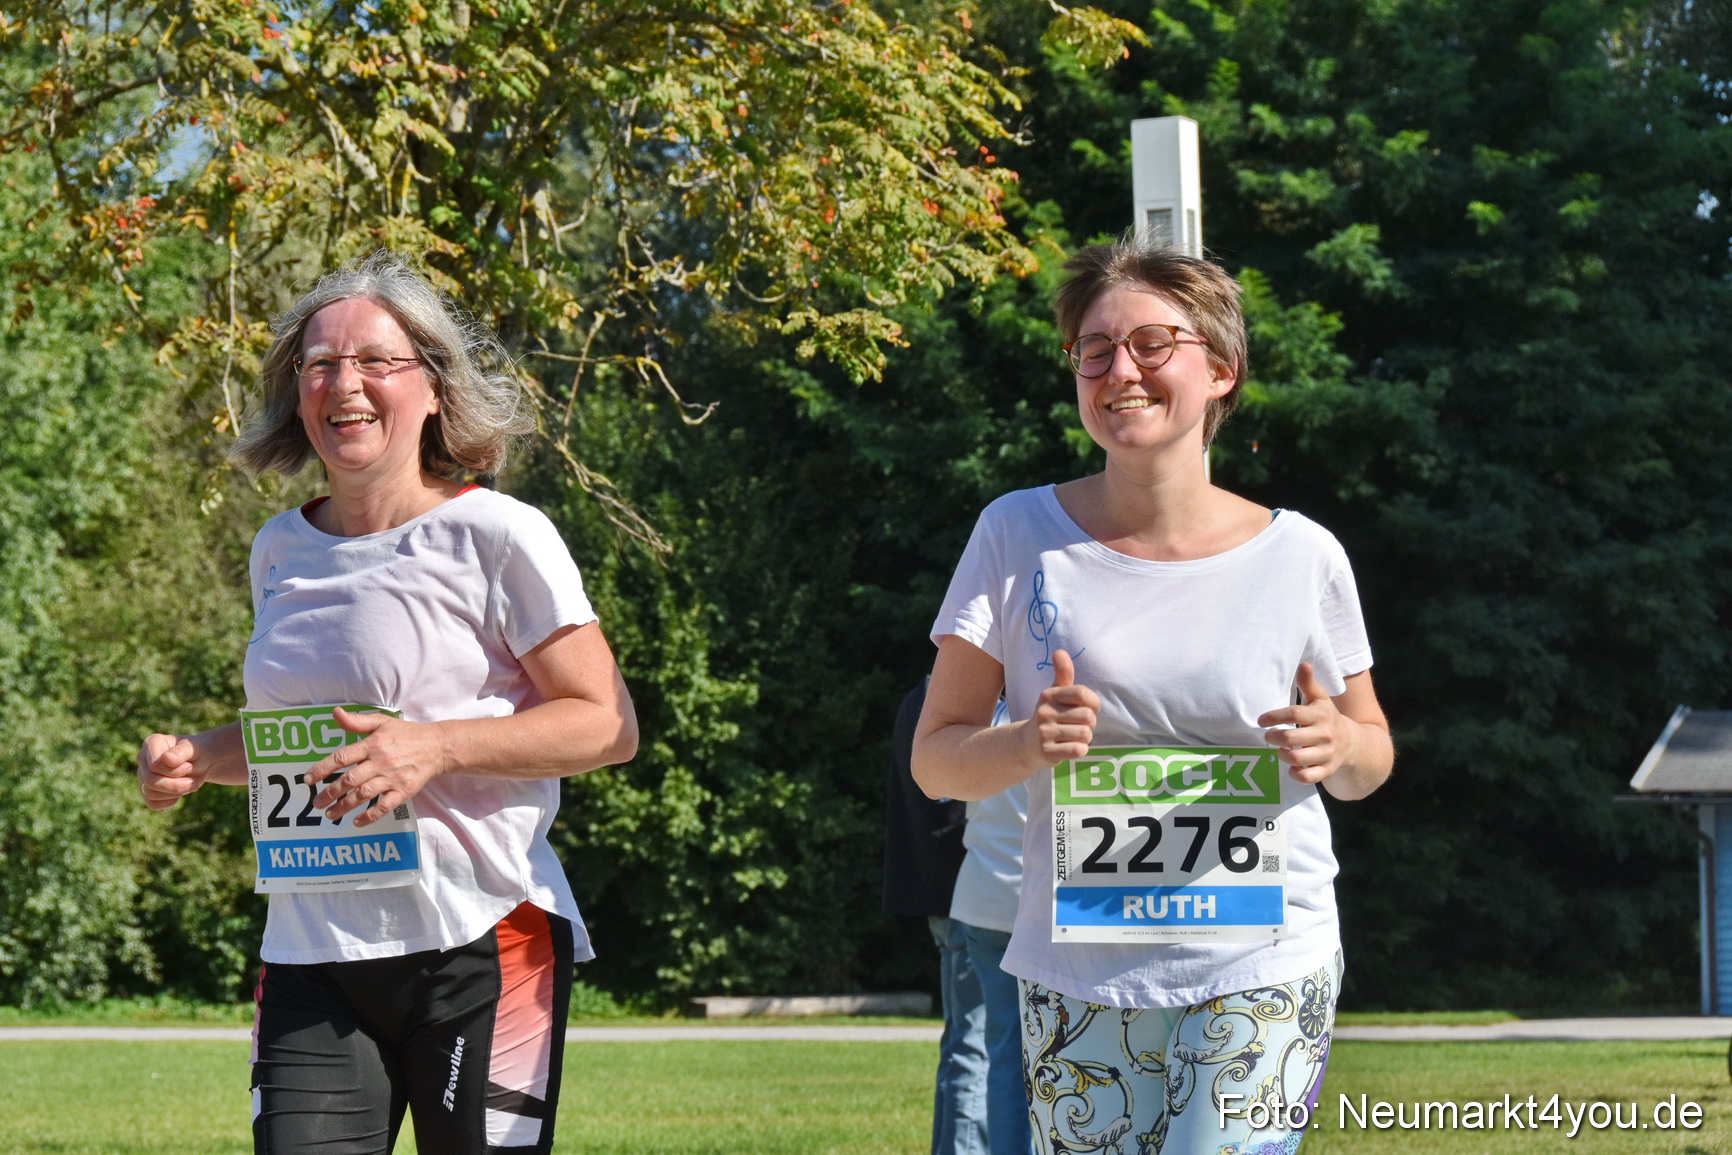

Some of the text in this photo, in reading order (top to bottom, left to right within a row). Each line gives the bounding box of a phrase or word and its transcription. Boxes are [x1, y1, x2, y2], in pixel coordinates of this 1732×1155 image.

[1072, 756, 1262, 796] BOCK
[1265, 821, 1275, 831] D
[269, 840, 401, 868] KATHARINA
[1081, 816, 1260, 874] 2276
[1123, 895, 1216, 919] RUTH
